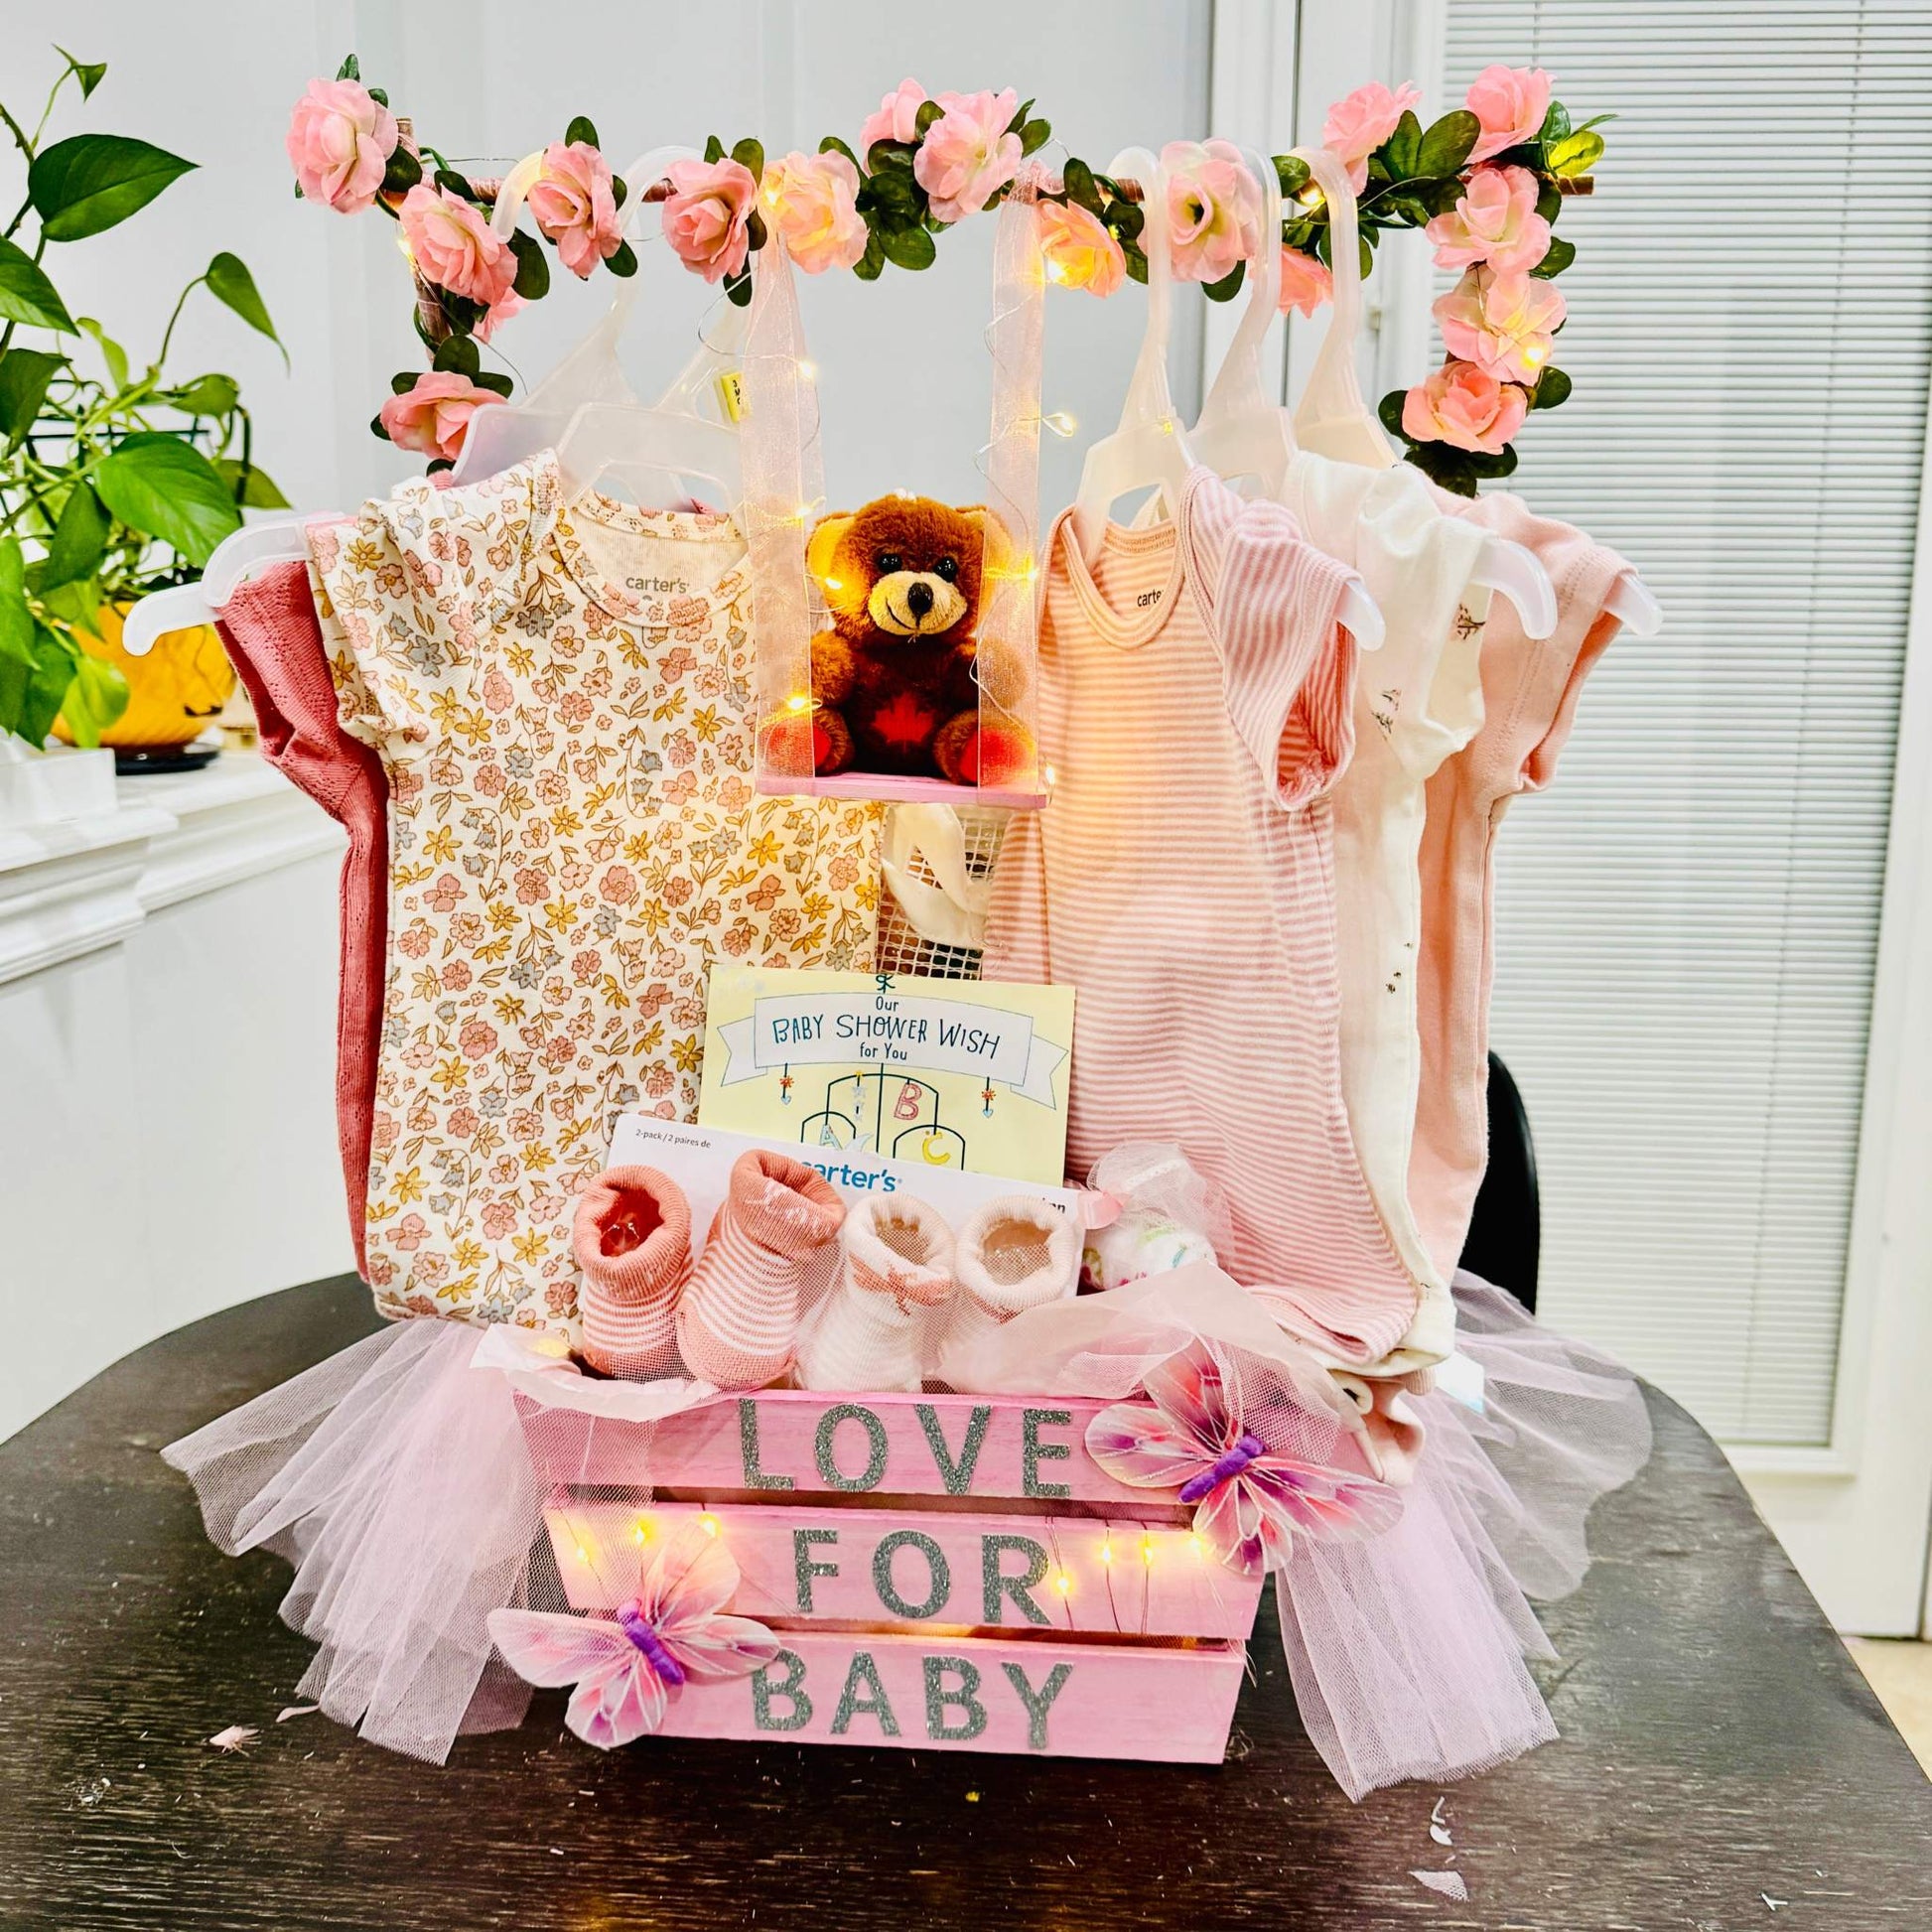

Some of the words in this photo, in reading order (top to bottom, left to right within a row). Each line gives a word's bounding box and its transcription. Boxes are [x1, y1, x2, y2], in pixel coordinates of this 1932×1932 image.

[625, 577, 688, 595] carter's
[1136, 589, 1164, 608] carte
[876, 996, 899, 1013] Our
[772, 1014, 824, 1044] BABY
[836, 1014, 928, 1043] SHOWER
[939, 1018, 1001, 1060] WISH
[860, 1041, 879, 1058] for
[885, 1042, 907, 1061] You
[674, 1135, 699, 1147] paires
[700, 1139, 712, 1149] de
[802, 1161, 897, 1192] arter's
[738, 1397, 1072, 1499] LOVE
[793, 1528, 1053, 1625] FOR
[751, 1648, 1075, 1750] BABY
